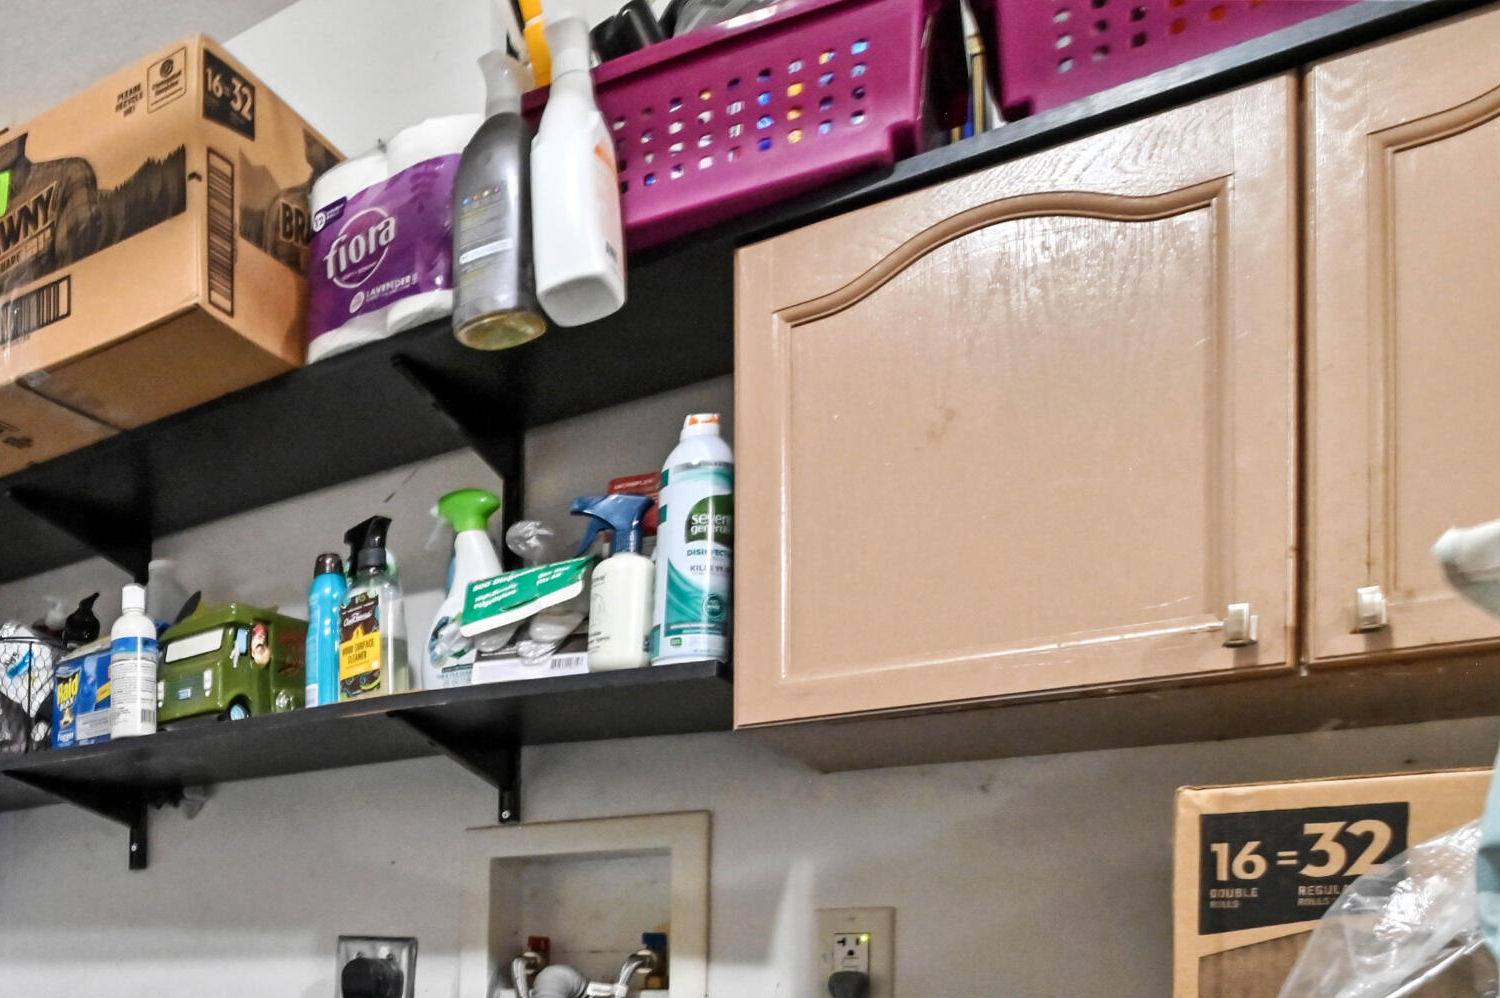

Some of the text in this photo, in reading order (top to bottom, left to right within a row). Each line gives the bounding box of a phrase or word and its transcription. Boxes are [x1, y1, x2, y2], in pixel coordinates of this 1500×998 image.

[323, 216, 397, 280] fiora
[691, 512, 732, 525] seen
[57, 673, 80, 705] Raid
[1209, 885, 1350, 898] DOUBLE REGUL
